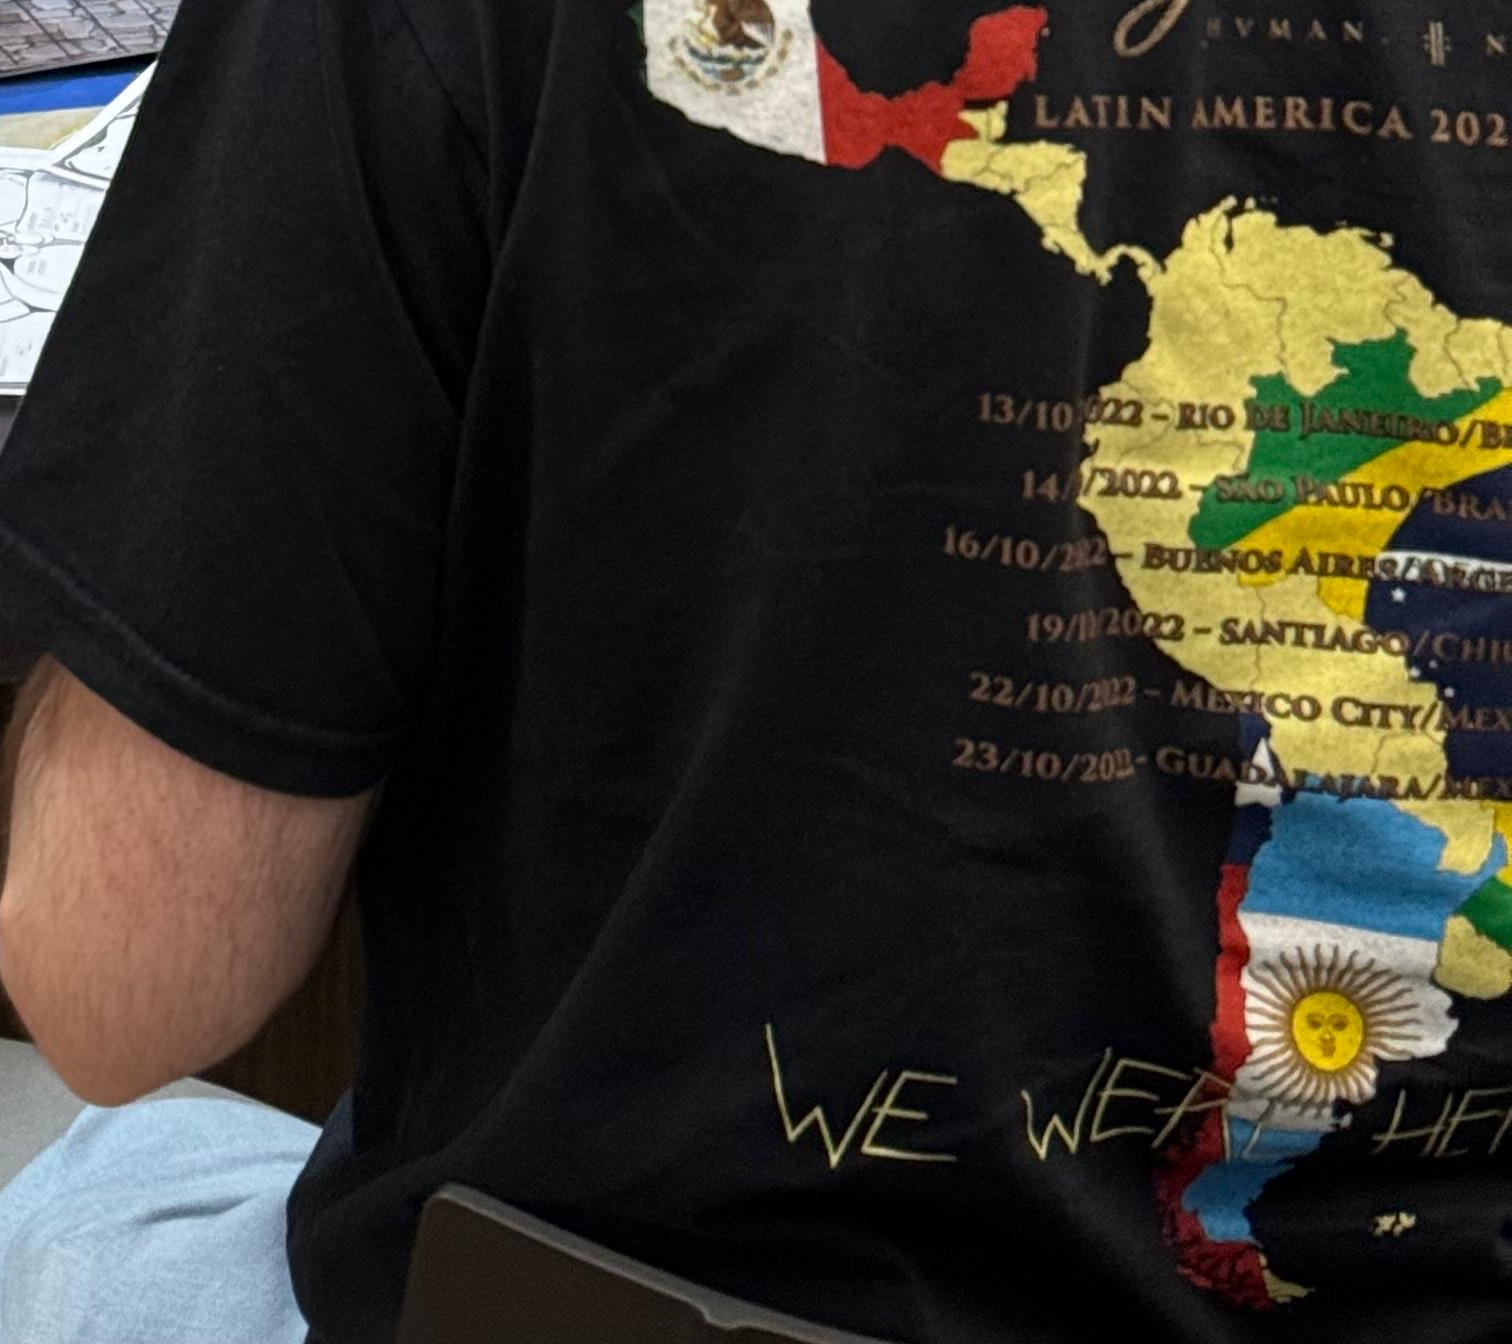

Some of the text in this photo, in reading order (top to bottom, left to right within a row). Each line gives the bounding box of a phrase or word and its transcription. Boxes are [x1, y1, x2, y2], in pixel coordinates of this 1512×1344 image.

[1035, 94, 1511, 148] LATIN AMERICA 202
[1175, 401, 1236, 431] RIO
[1244, 397, 1288, 432] DE
[1142, 542, 1283, 575] BUENOS
[1170, 681, 1323, 722] MEXICO
[765, 1023, 959, 1170] WE
